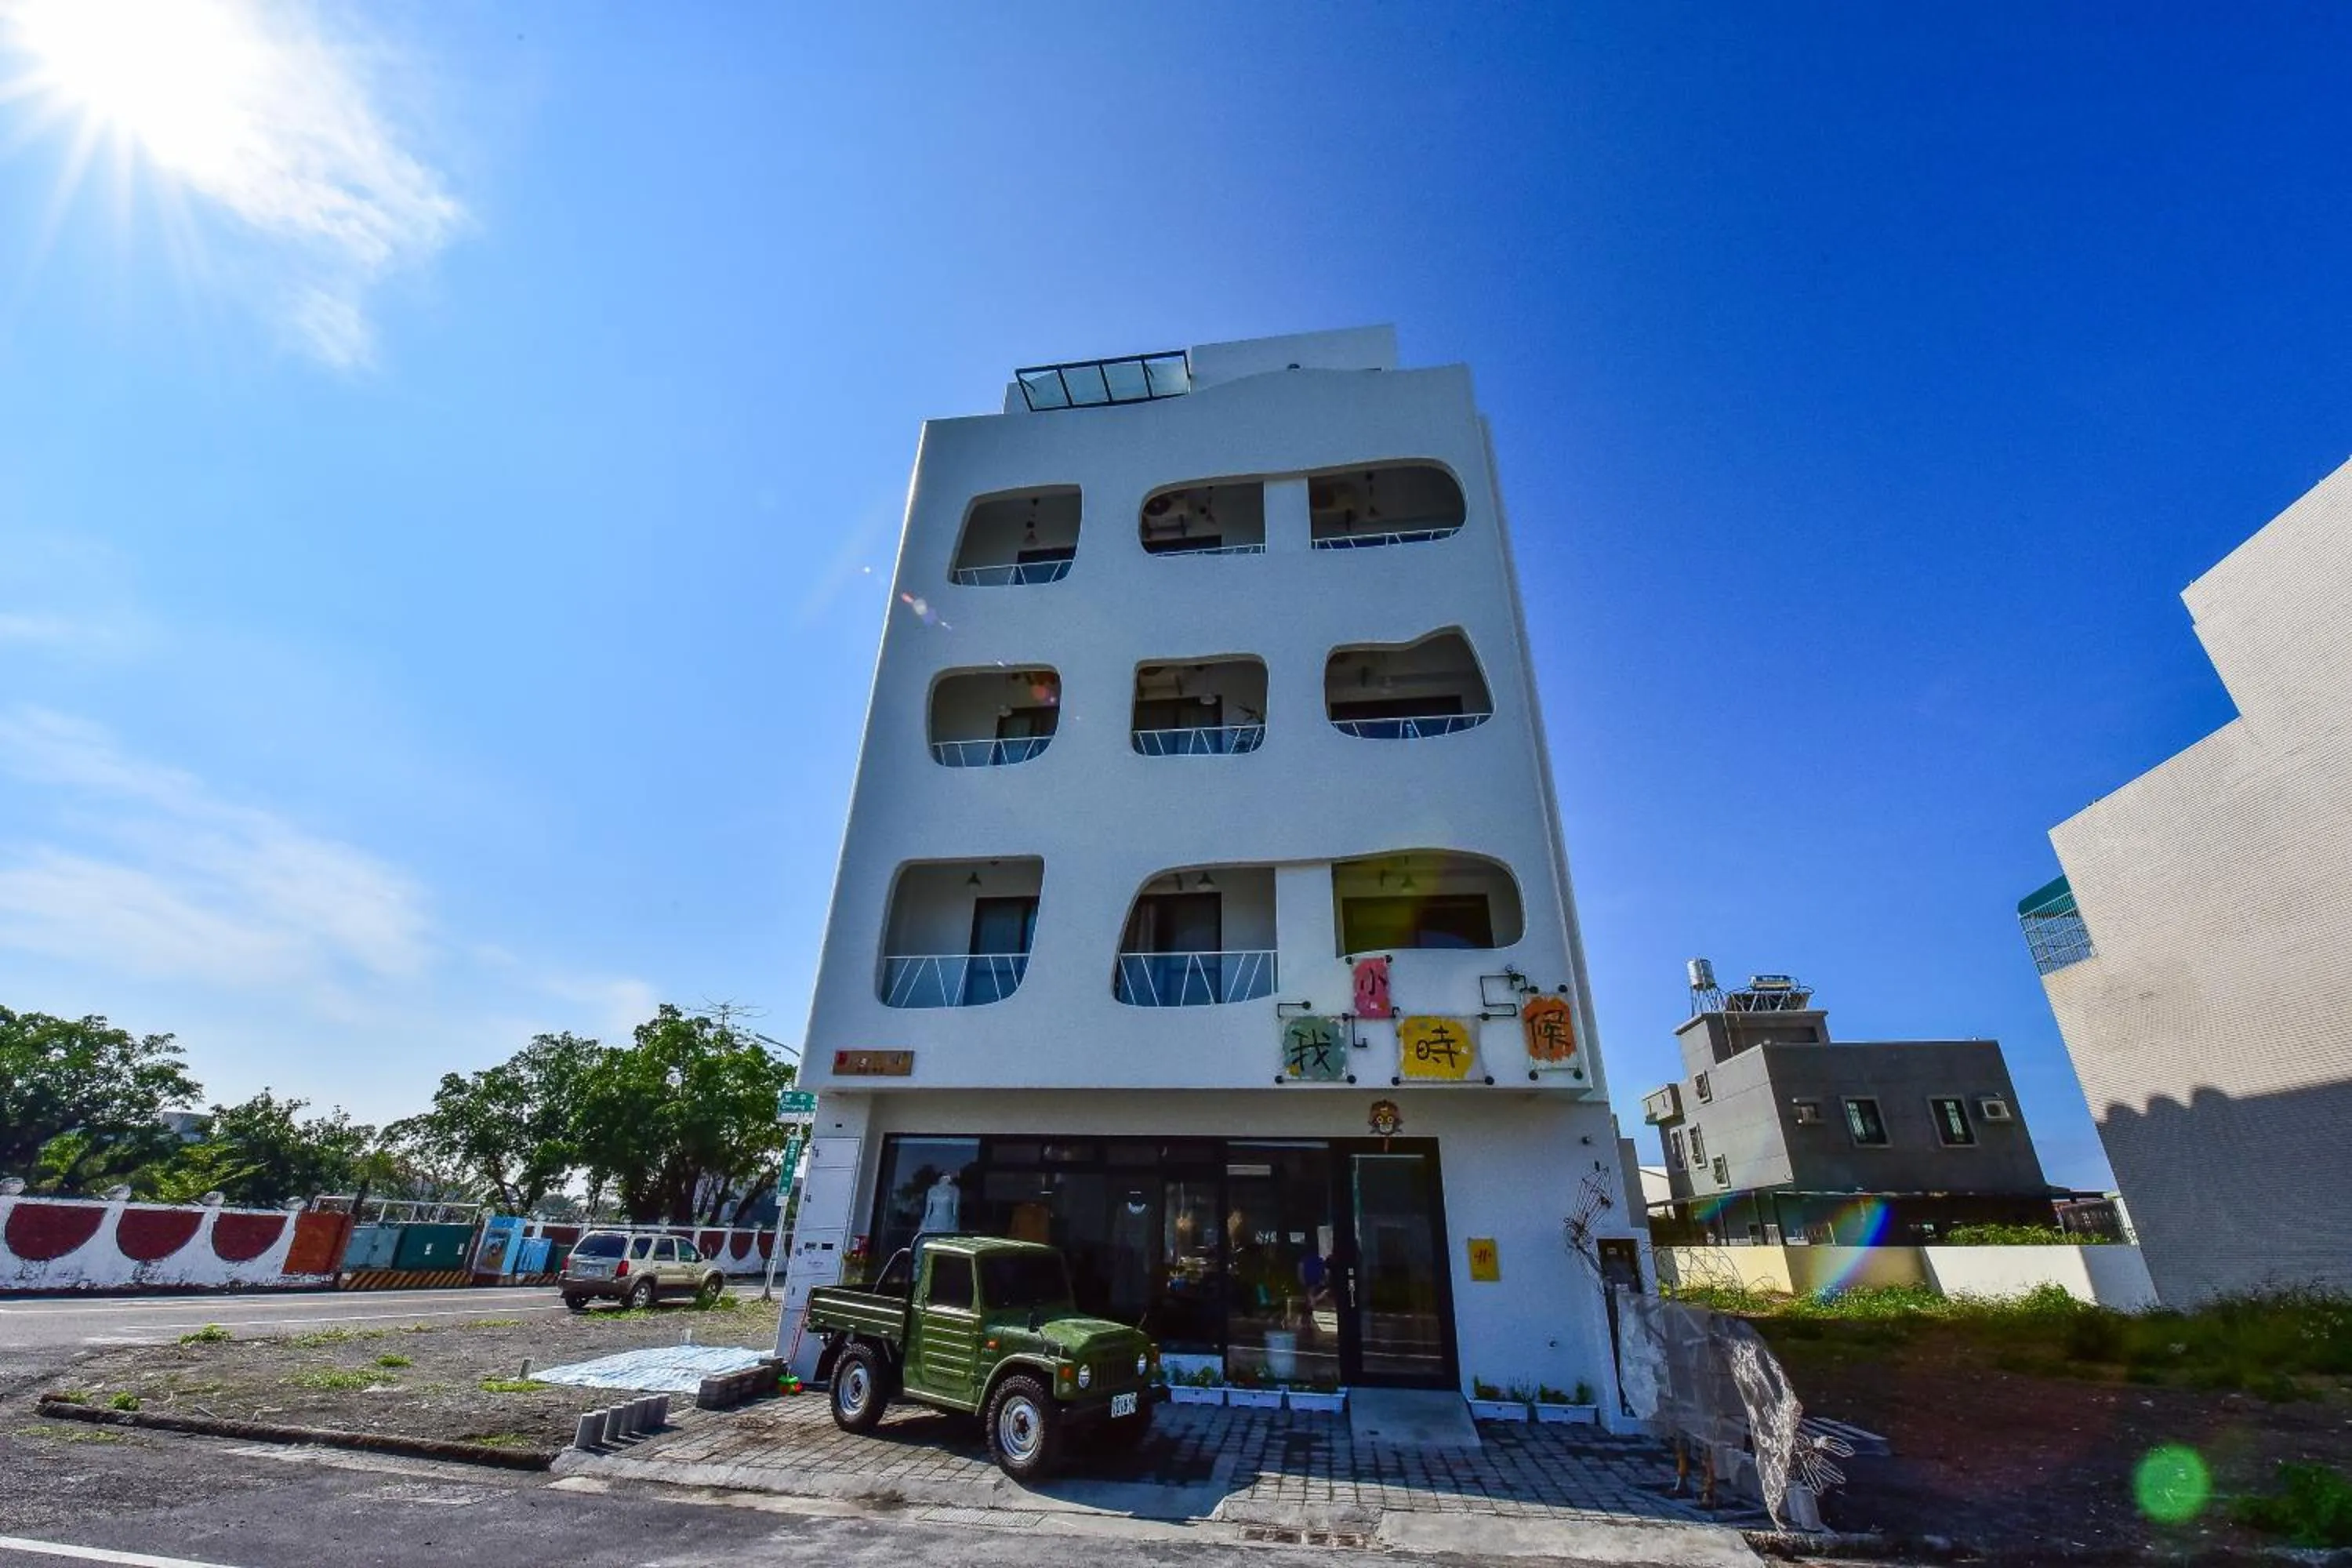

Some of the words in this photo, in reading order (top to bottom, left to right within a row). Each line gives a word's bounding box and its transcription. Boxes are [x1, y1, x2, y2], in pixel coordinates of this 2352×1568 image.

[1290, 1029, 1331, 1072] 我
[1360, 968, 1388, 996] 小
[1416, 1025, 1459, 1069] 時
[1529, 1009, 1571, 1051] 候
